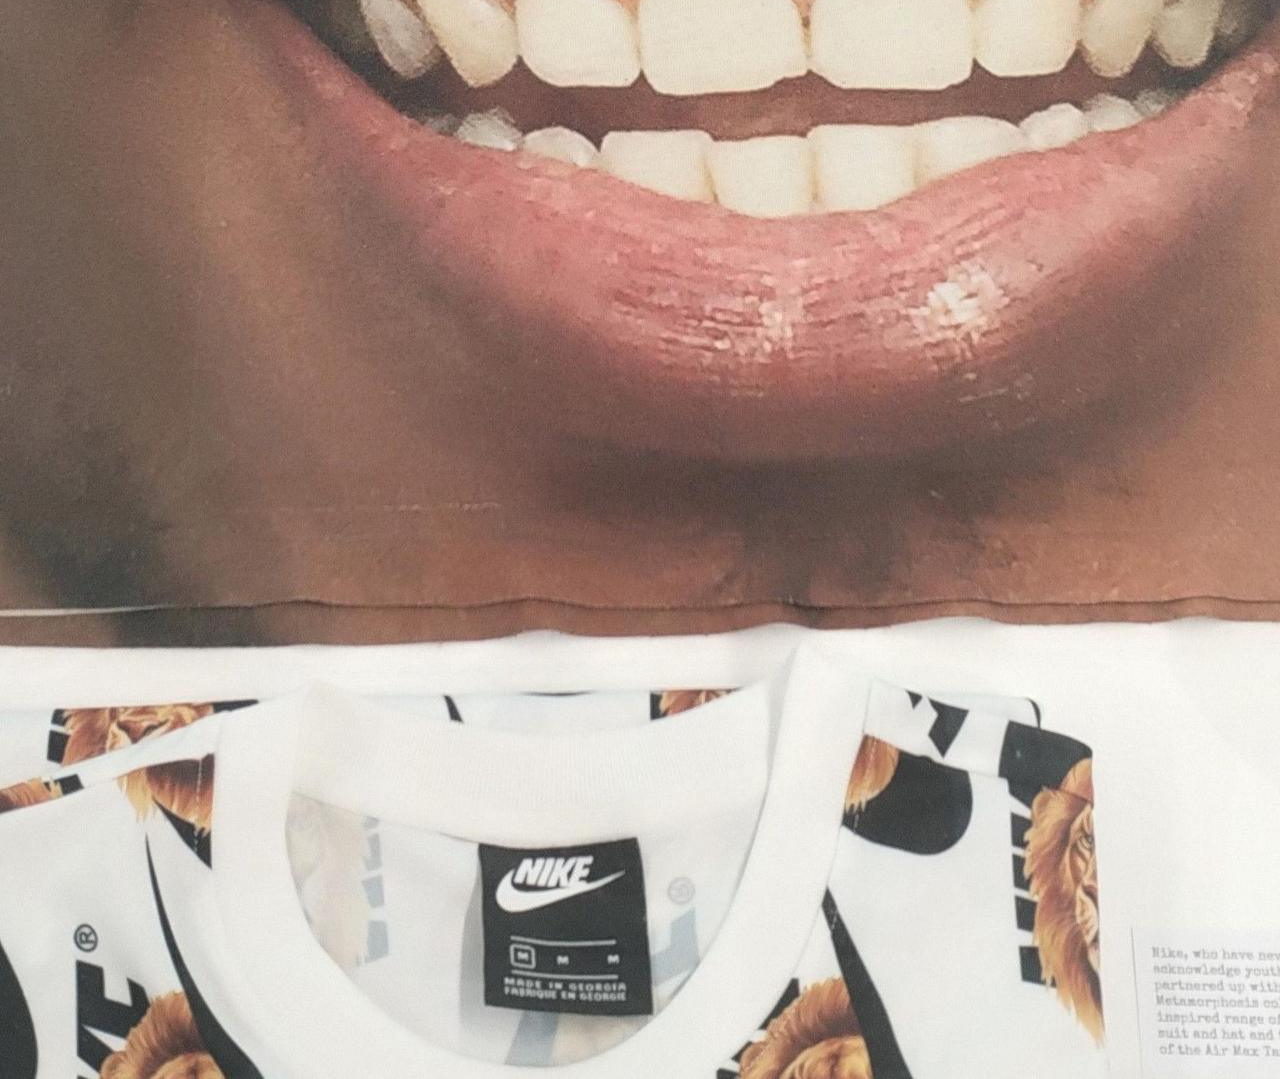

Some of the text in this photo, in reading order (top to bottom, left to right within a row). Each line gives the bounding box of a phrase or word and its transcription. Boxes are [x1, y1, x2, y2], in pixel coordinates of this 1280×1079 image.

[514, 855, 594, 888] NIKE
[556, 955, 569, 966] M
[607, 954, 620, 965] M
[503, 977, 627, 992] MADE IN GEORGIA
[560, 990, 576, 1001] EN
